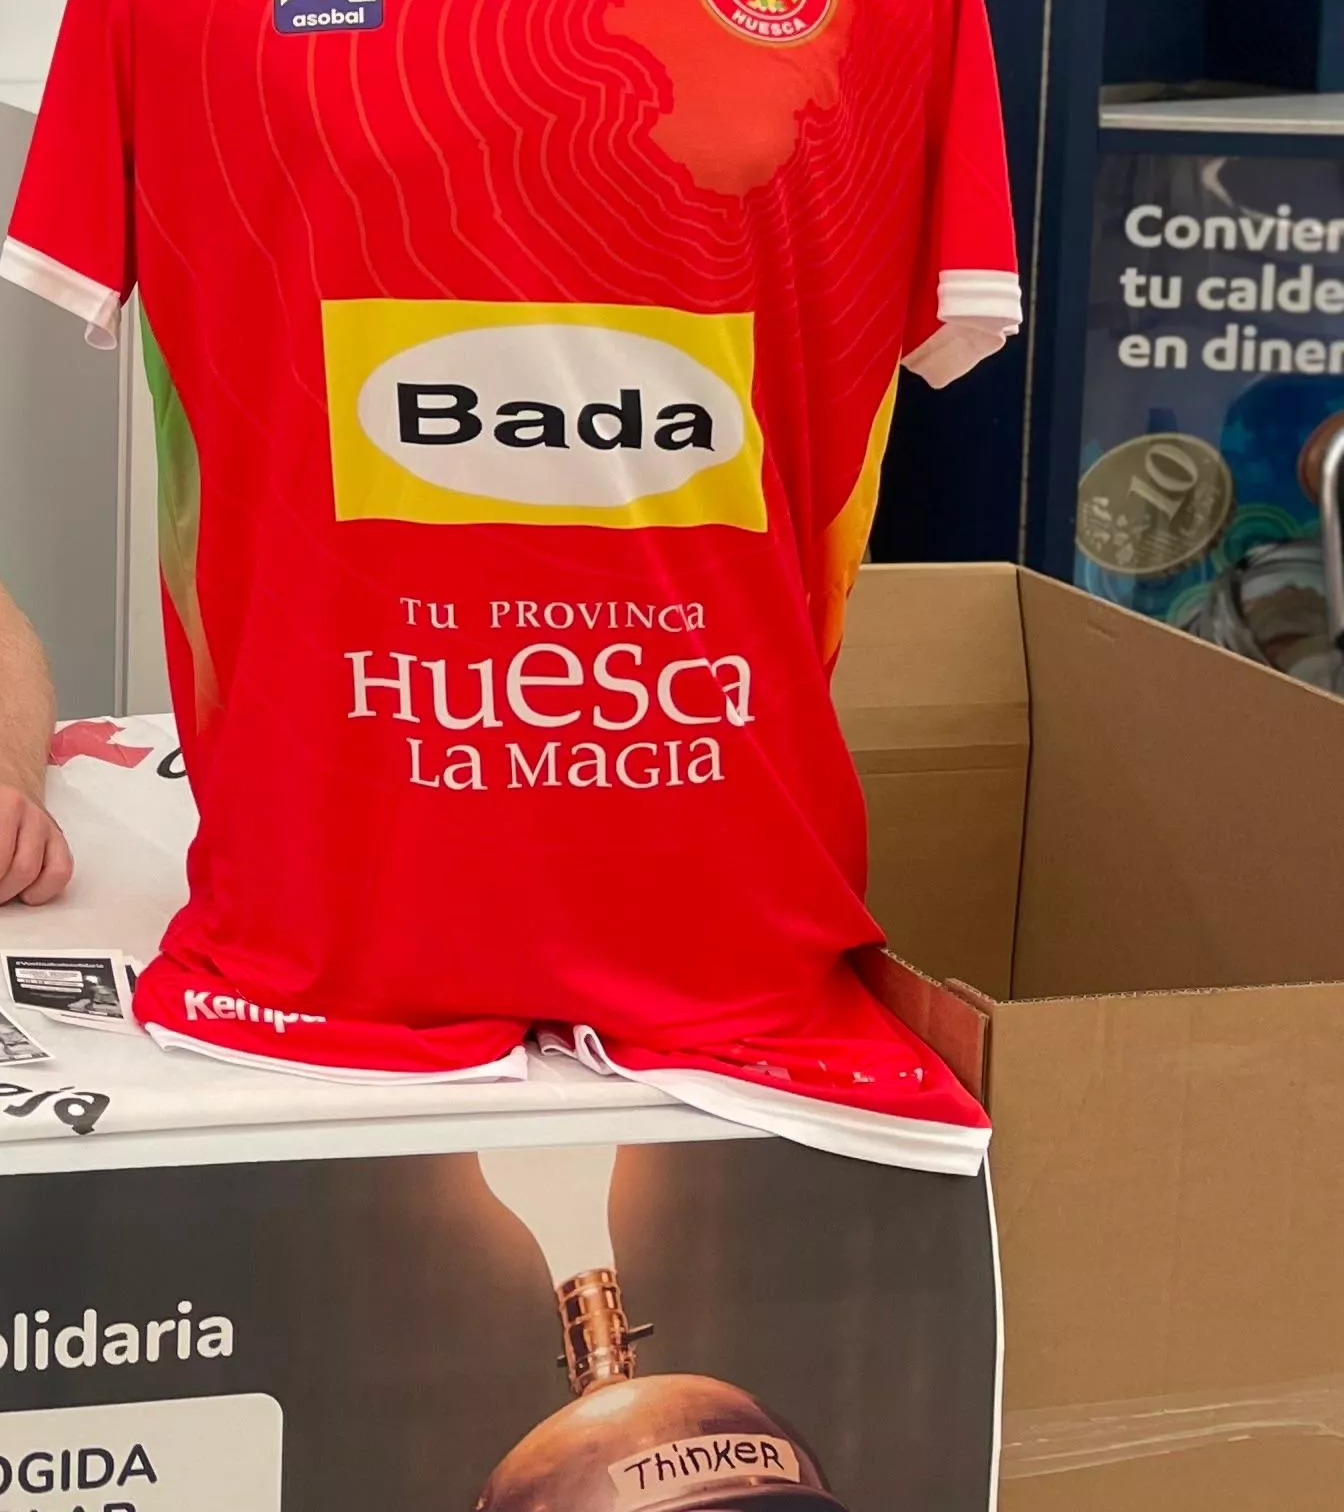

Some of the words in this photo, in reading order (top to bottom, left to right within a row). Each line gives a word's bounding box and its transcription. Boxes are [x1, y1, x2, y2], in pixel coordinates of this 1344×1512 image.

[292, 6, 365, 27] asobal
[730, 8, 807, 36] HUESCA
[1119, 265, 1182, 310] tu
[1117, 333, 1188, 369] en
[396, 382, 716, 452] Bada
[1129, 441, 1200, 517] 10
